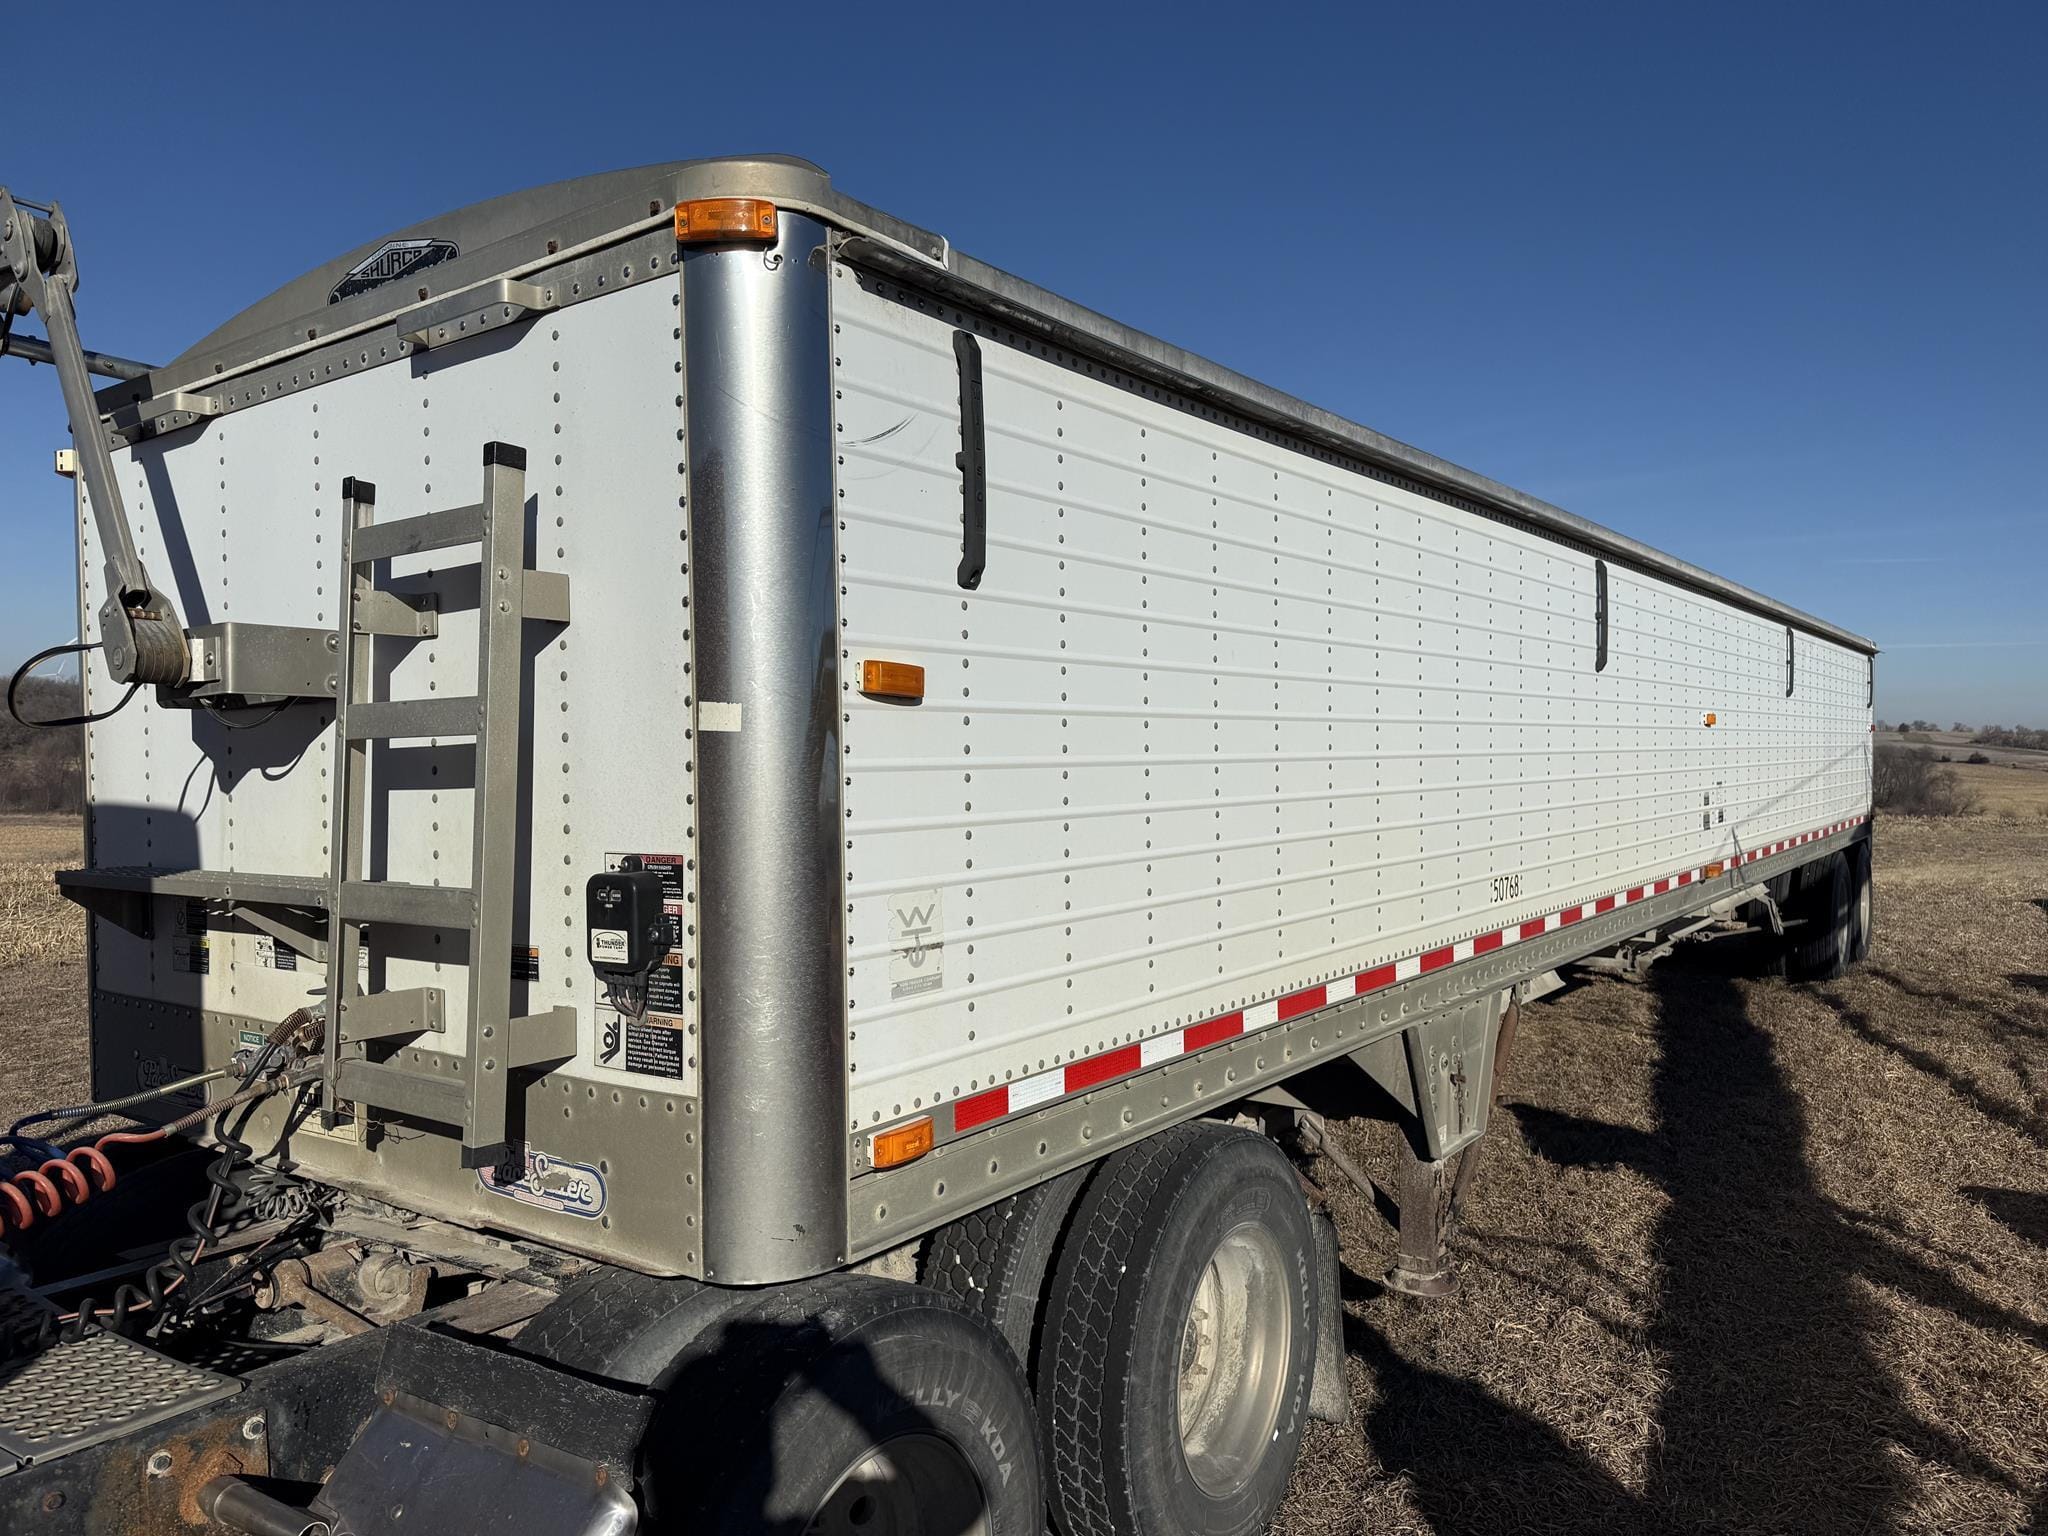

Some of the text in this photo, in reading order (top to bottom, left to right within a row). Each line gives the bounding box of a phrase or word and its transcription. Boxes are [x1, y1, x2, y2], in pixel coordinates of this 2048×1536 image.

[360, 250, 422, 278] SHURCO
[646, 856, 676, 864] DANGER
[1494, 874, 1519, 902] 50768
[243, 1034, 260, 1043] NOTICE
[1297, 1249, 1310, 1331] KELLY
[980, 1416, 1012, 1489] KDA
